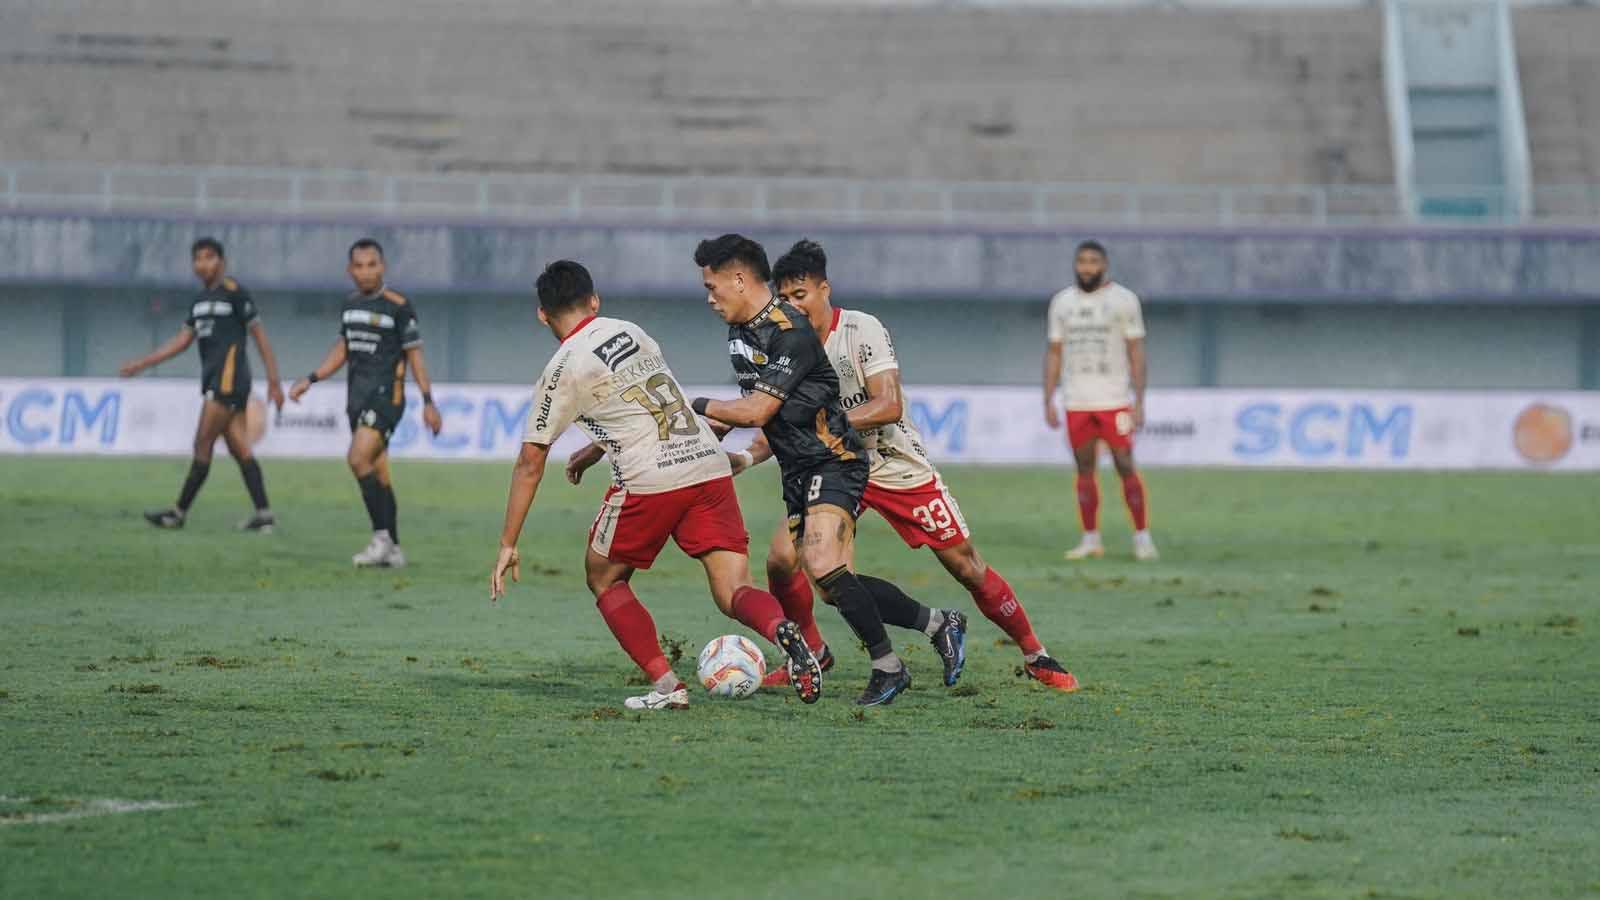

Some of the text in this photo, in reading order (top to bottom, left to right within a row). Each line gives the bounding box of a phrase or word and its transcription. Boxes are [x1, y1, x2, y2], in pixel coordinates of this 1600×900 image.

[0, 389, 121, 445] CM
[536, 393, 553, 431] Vidio
[619, 372, 701, 441] 18
[1232, 402, 1414, 458] SCM
[912, 498, 952, 532] 33
